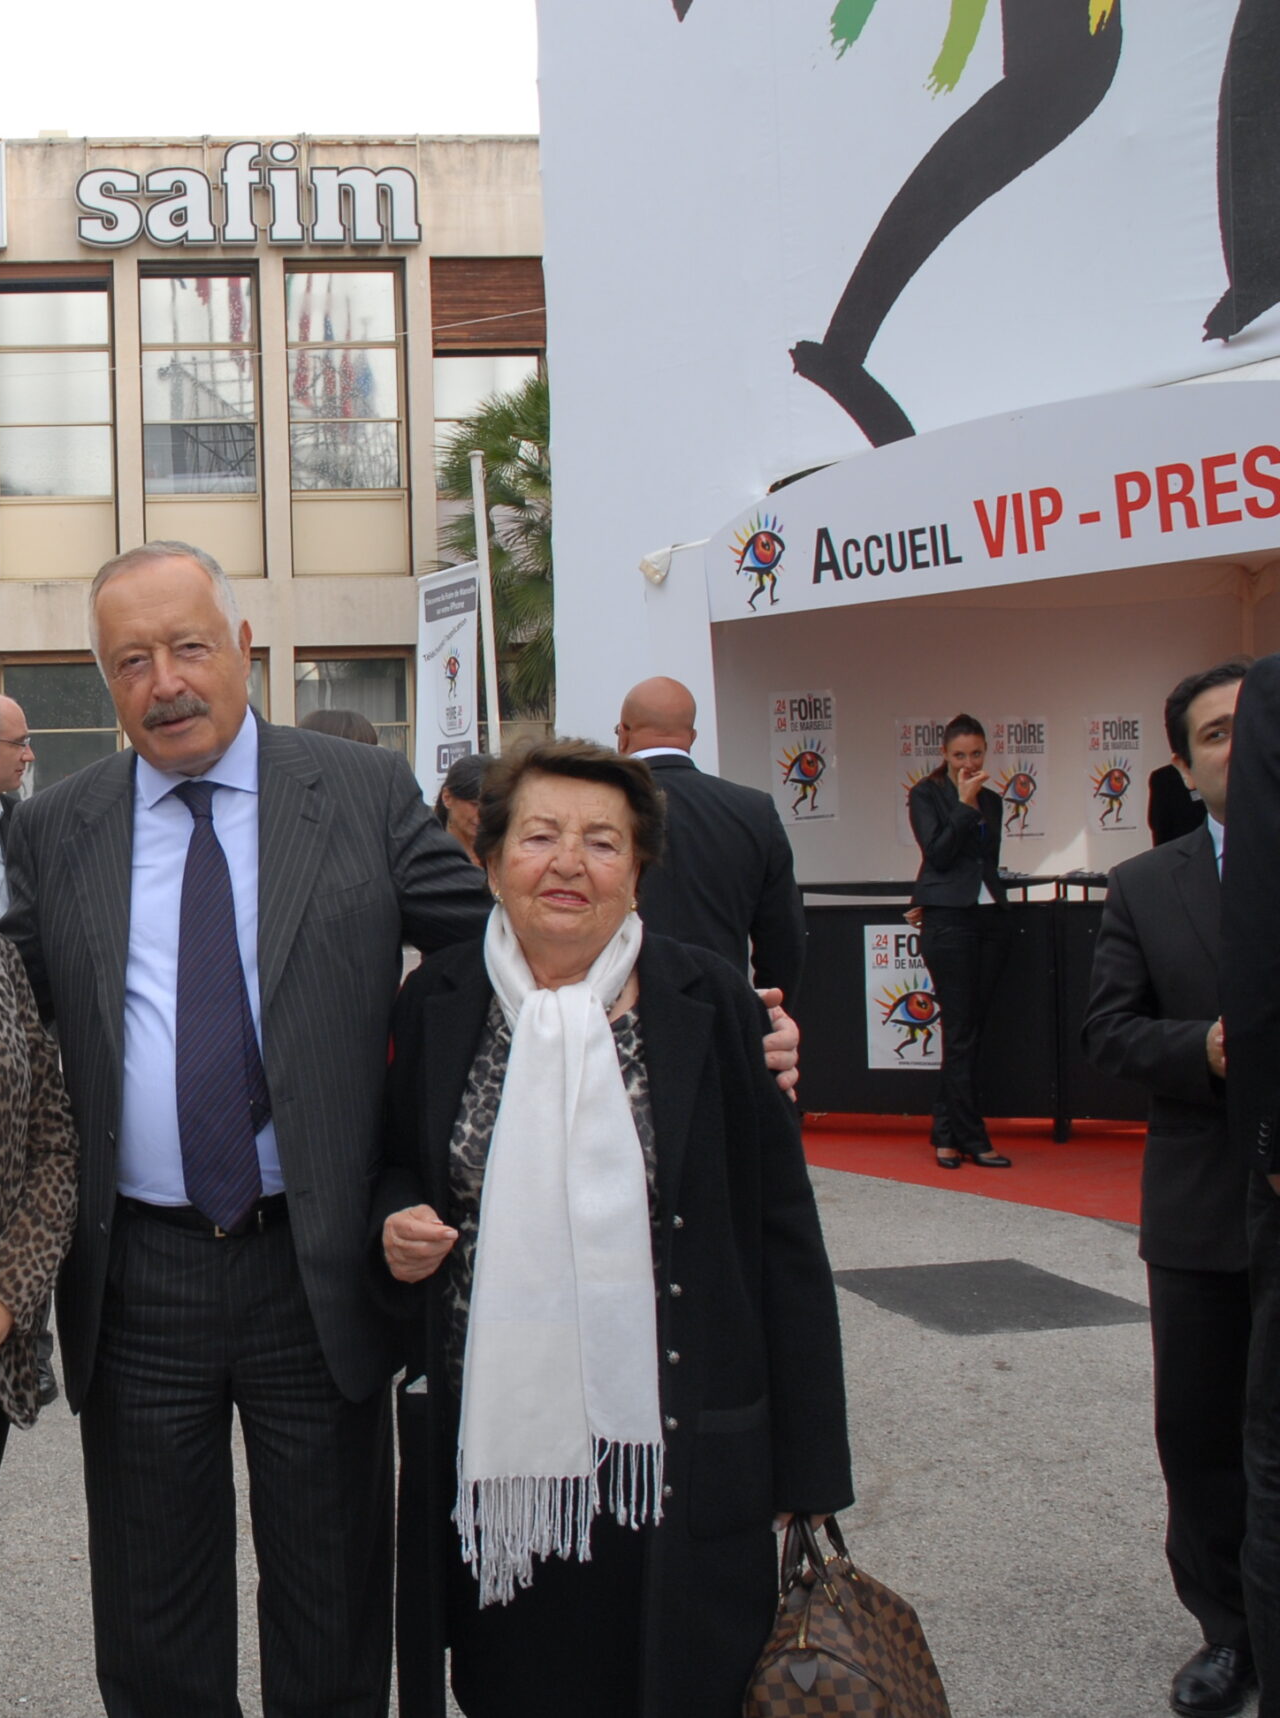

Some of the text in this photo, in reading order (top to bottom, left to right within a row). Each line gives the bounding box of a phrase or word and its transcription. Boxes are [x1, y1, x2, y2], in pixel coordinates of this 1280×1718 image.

[75, 140, 423, 246] safim
[973, 486, 1063, 559] VIP
[776, 699, 786, 713] 24
[777, 717, 787, 729] 04
[876, 934, 889, 947] 24
[876, 952, 889, 966] 04
[894, 958, 907, 969] DE
